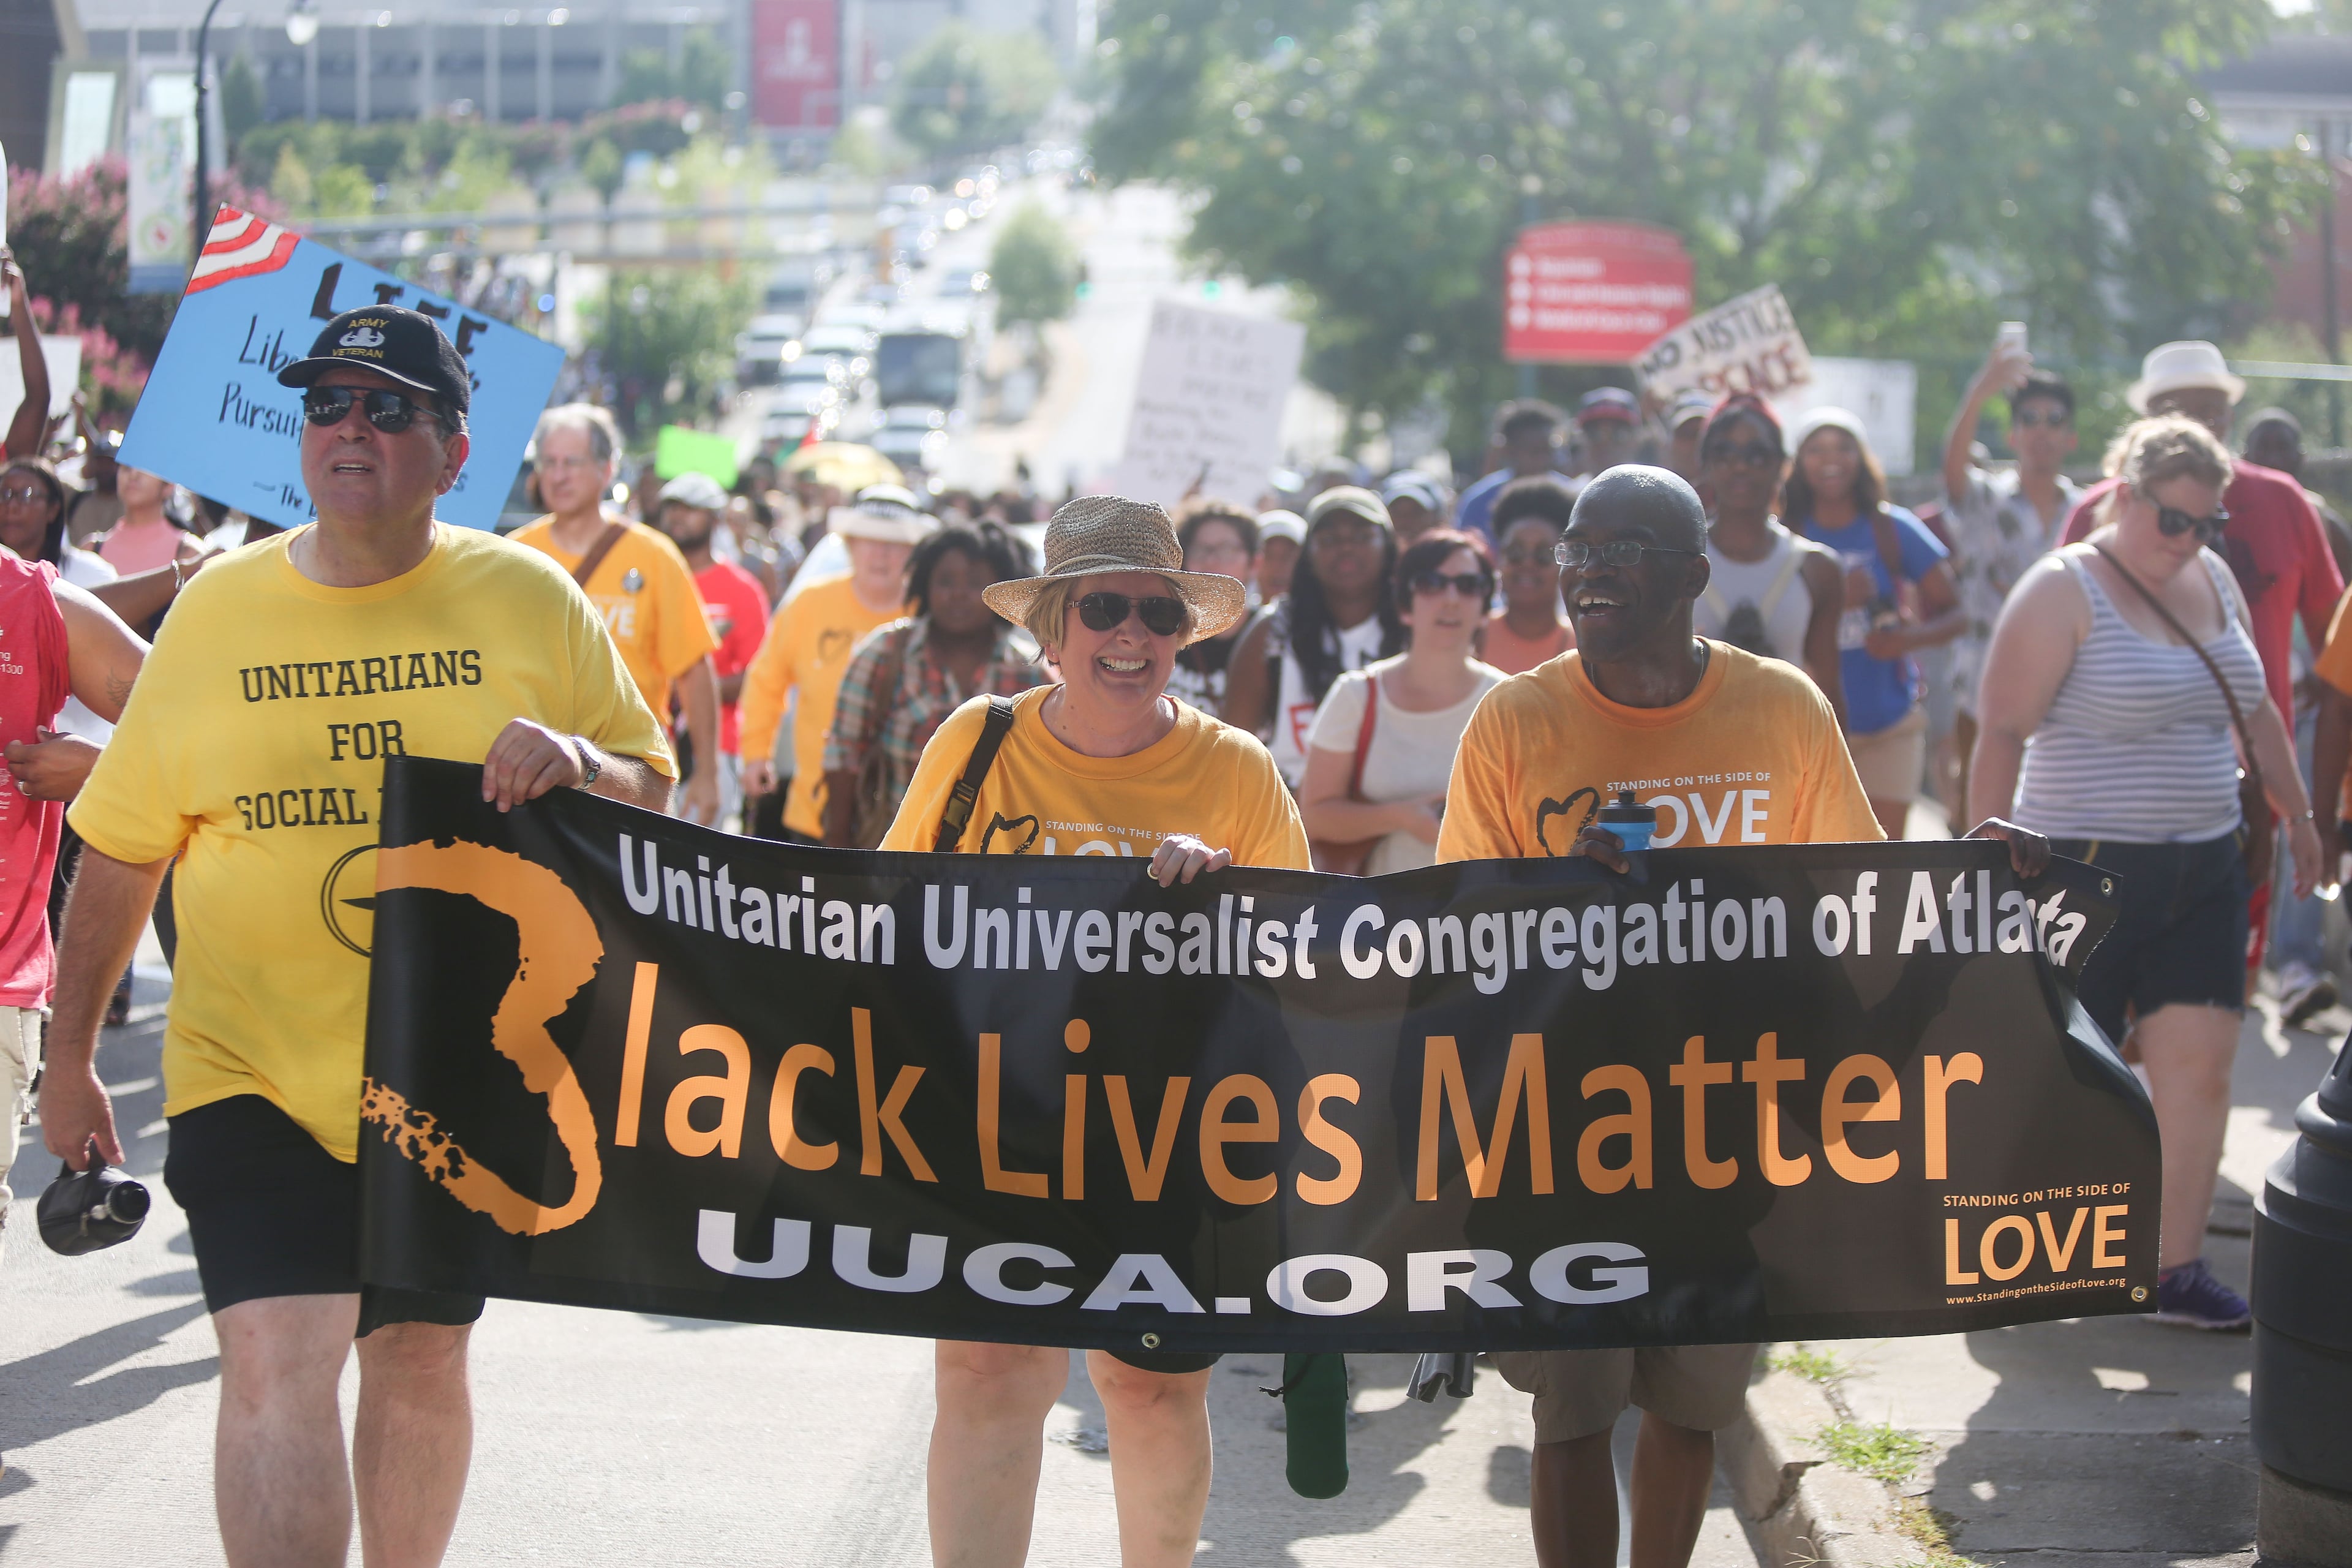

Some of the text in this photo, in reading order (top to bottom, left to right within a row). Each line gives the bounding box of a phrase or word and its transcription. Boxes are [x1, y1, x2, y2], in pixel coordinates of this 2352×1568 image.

[348, 318, 390, 328] ARMY
[333, 348, 384, 358] VETERAN
[239, 649, 482, 703] UNITARIANS
[327, 719, 407, 761] FOR
[1607, 772, 1771, 792] STANDING ON THE SIDE OF
[235, 788, 368, 831] SOCIAL
[1046, 821, 1102, 832] STANDING
[1107, 826, 1125, 835] ON
[1129, 828, 1152, 839] THE
[619, 833, 2087, 995] Unitarian Universalist Congregation of Atlata
[977, 1018, 1363, 1205] Lives
[1415, 1031, 1985, 1202] Matter
[1943, 1183, 2130, 1207] STANDING ON THE SIDE OF
[696, 1208, 1649, 1317] UUCA.ORG
[1945, 1204, 2128, 1285] LOVE
[1947, 1278, 2126, 1305] www.StandingontheSideofLove.org
